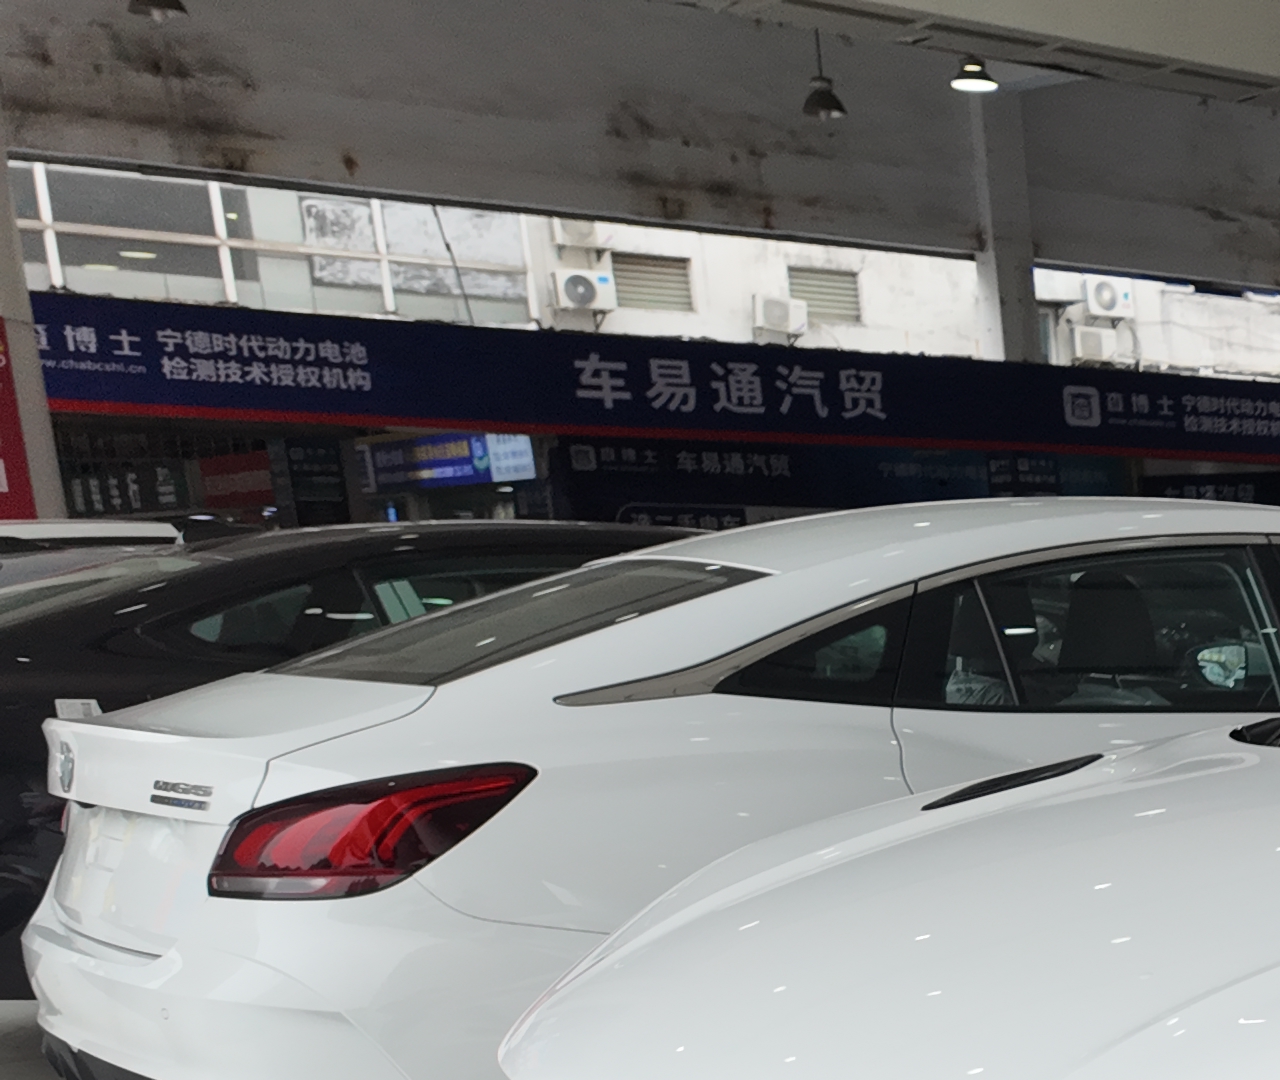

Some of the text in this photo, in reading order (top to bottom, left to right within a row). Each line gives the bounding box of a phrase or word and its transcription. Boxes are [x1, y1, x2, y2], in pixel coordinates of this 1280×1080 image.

[156, 327, 369, 366] 宁德时代动力电池
[160, 355, 373, 393] 检测技术授权机构
[573, 352, 887, 421] 车易通汽贸
[676, 450, 791, 478] 车易通汽贸
